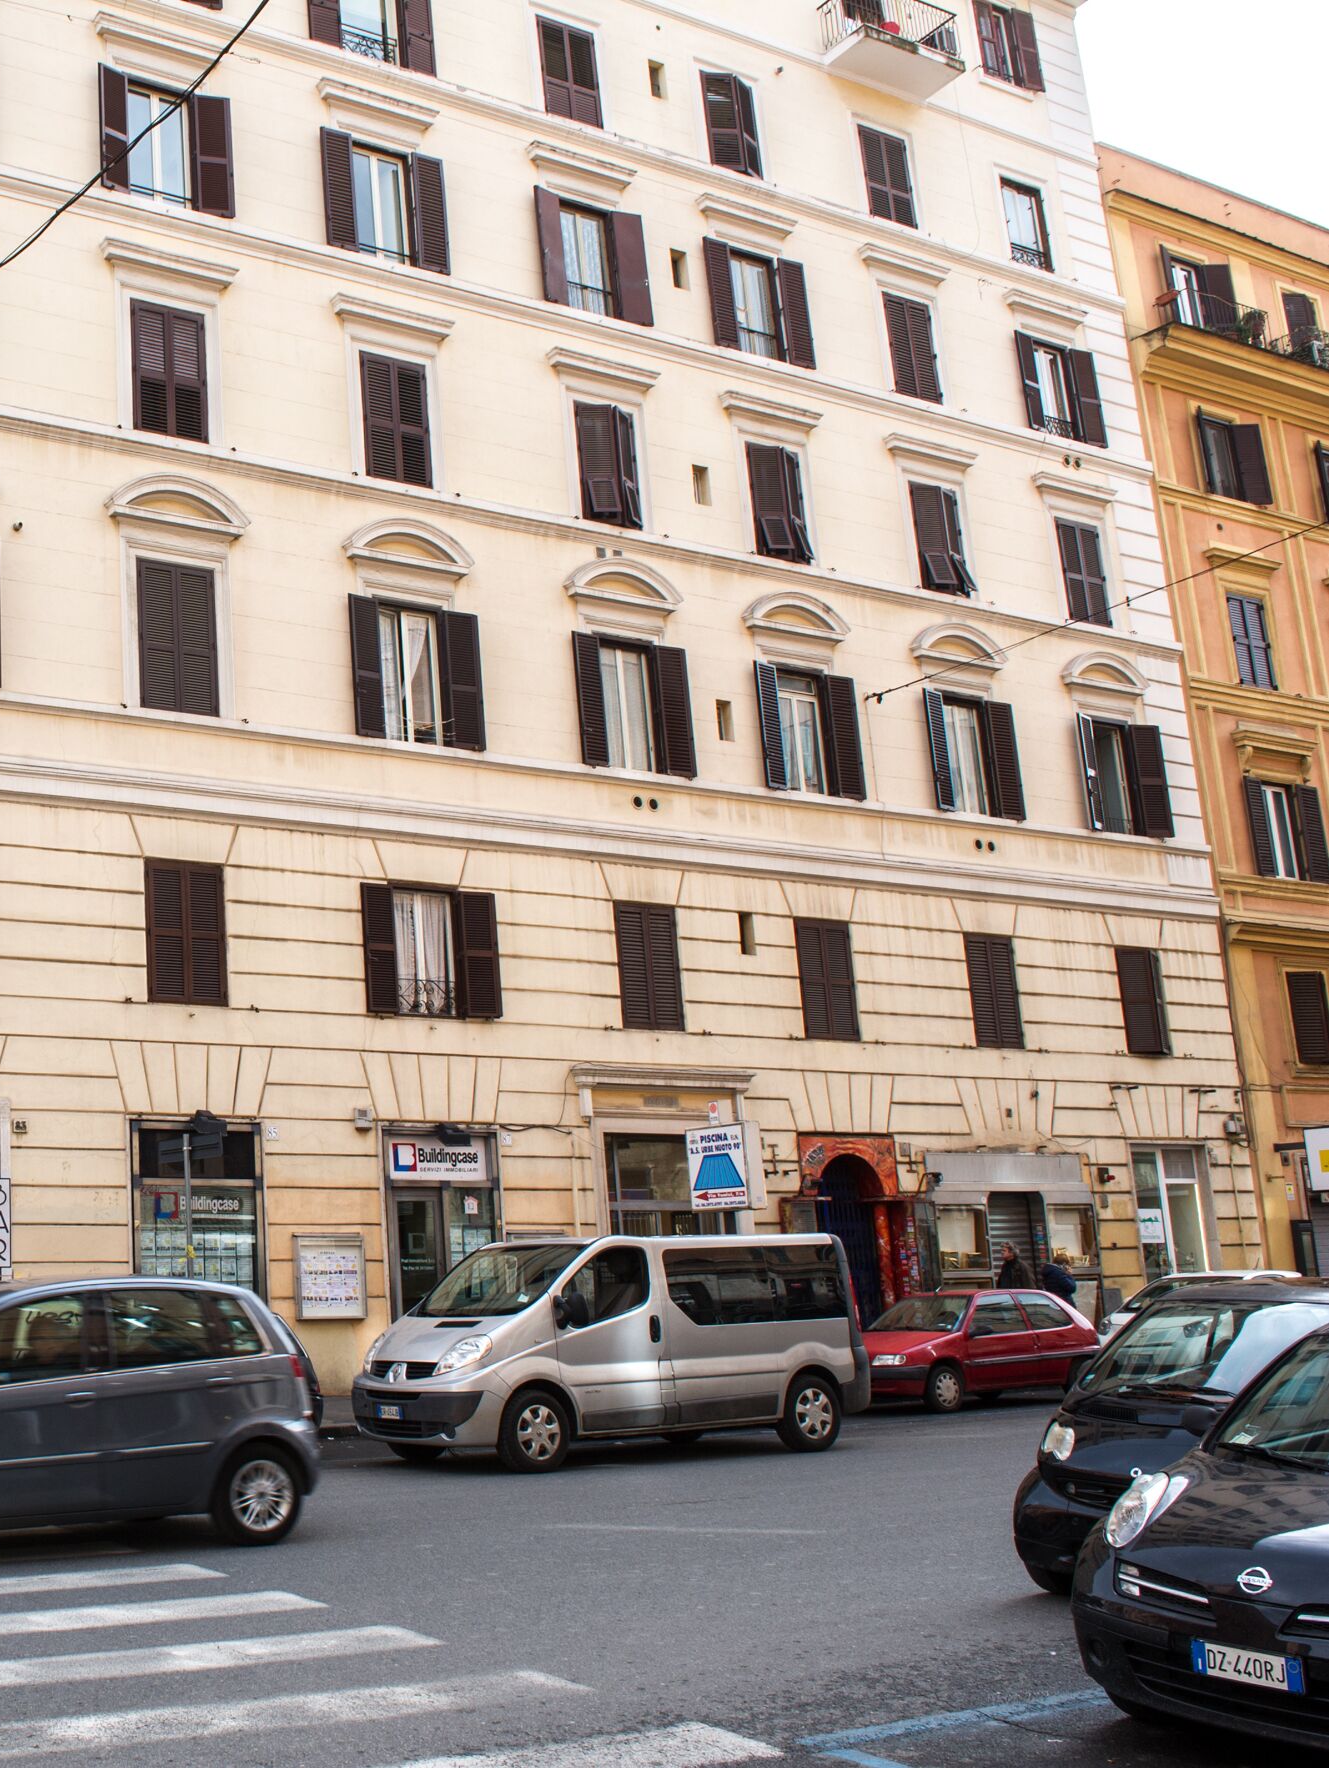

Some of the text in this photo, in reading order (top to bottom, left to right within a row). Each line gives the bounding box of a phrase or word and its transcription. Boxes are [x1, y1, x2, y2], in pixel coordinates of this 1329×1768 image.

[700, 1132, 728, 1144] PISCINA
[701, 1145, 714, 1153] URBE
[714, 1143, 732, 1152] NUOTO
[418, 1148, 478, 1167] Buildingcase
[179, 1195, 239, 1214] Bildingcase
[1239, 1575, 1270, 1585] NISSAN
